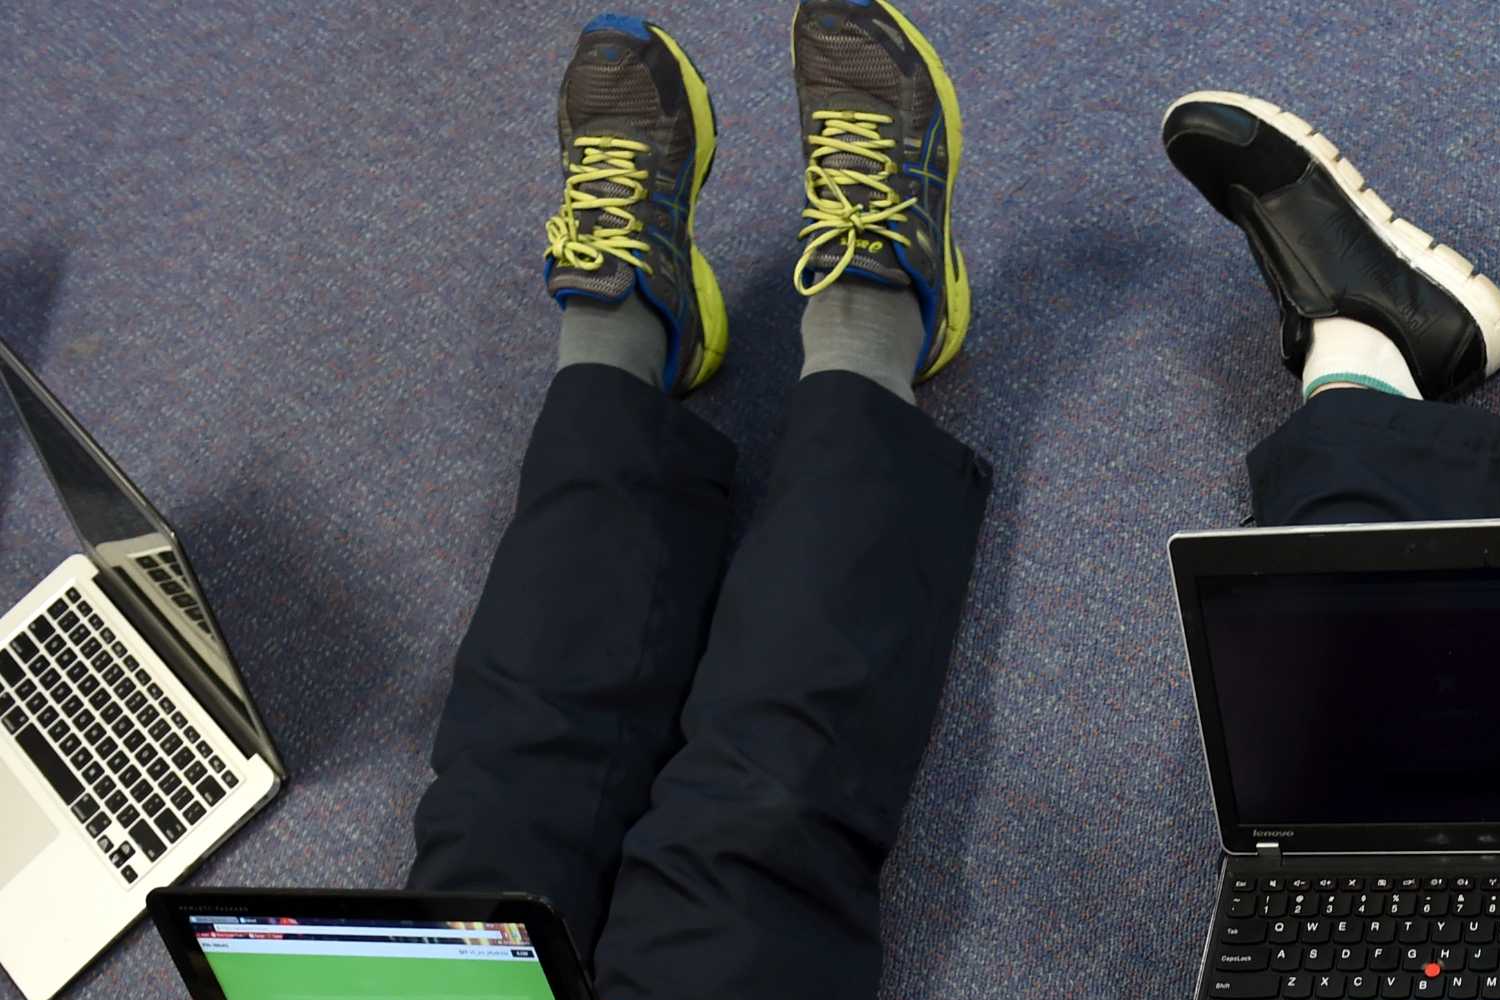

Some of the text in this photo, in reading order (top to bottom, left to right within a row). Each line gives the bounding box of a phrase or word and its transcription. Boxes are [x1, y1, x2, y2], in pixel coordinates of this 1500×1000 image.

[1274, 922, 1284, 932] Q
[1307, 922, 1319, 932] W
[1338, 921, 1347, 932] E
[1370, 922, 1380, 931] R
[1404, 921, 1412, 931] T
[1437, 921, 1446, 931] Y
[1469, 921, 1478, 932] U
[1276, 949, 1286, 959] A
[1309, 948, 1318, 959] S
[1341, 948, 1350, 959] D
[1374, 948, 1383, 958] F
[1408, 948, 1417, 959] G
[1440, 950, 1450, 959] H
[1474, 948, 1482, 958] J
[1288, 976, 1296, 986] Z
[1320, 976, 1330, 986] X
[1353, 976, 1362, 987] C
[1387, 976, 1396, 986] V
[1418, 980, 1428, 990] B
[1452, 976, 1462, 987] N
[1486, 976, 1497, 987] M
